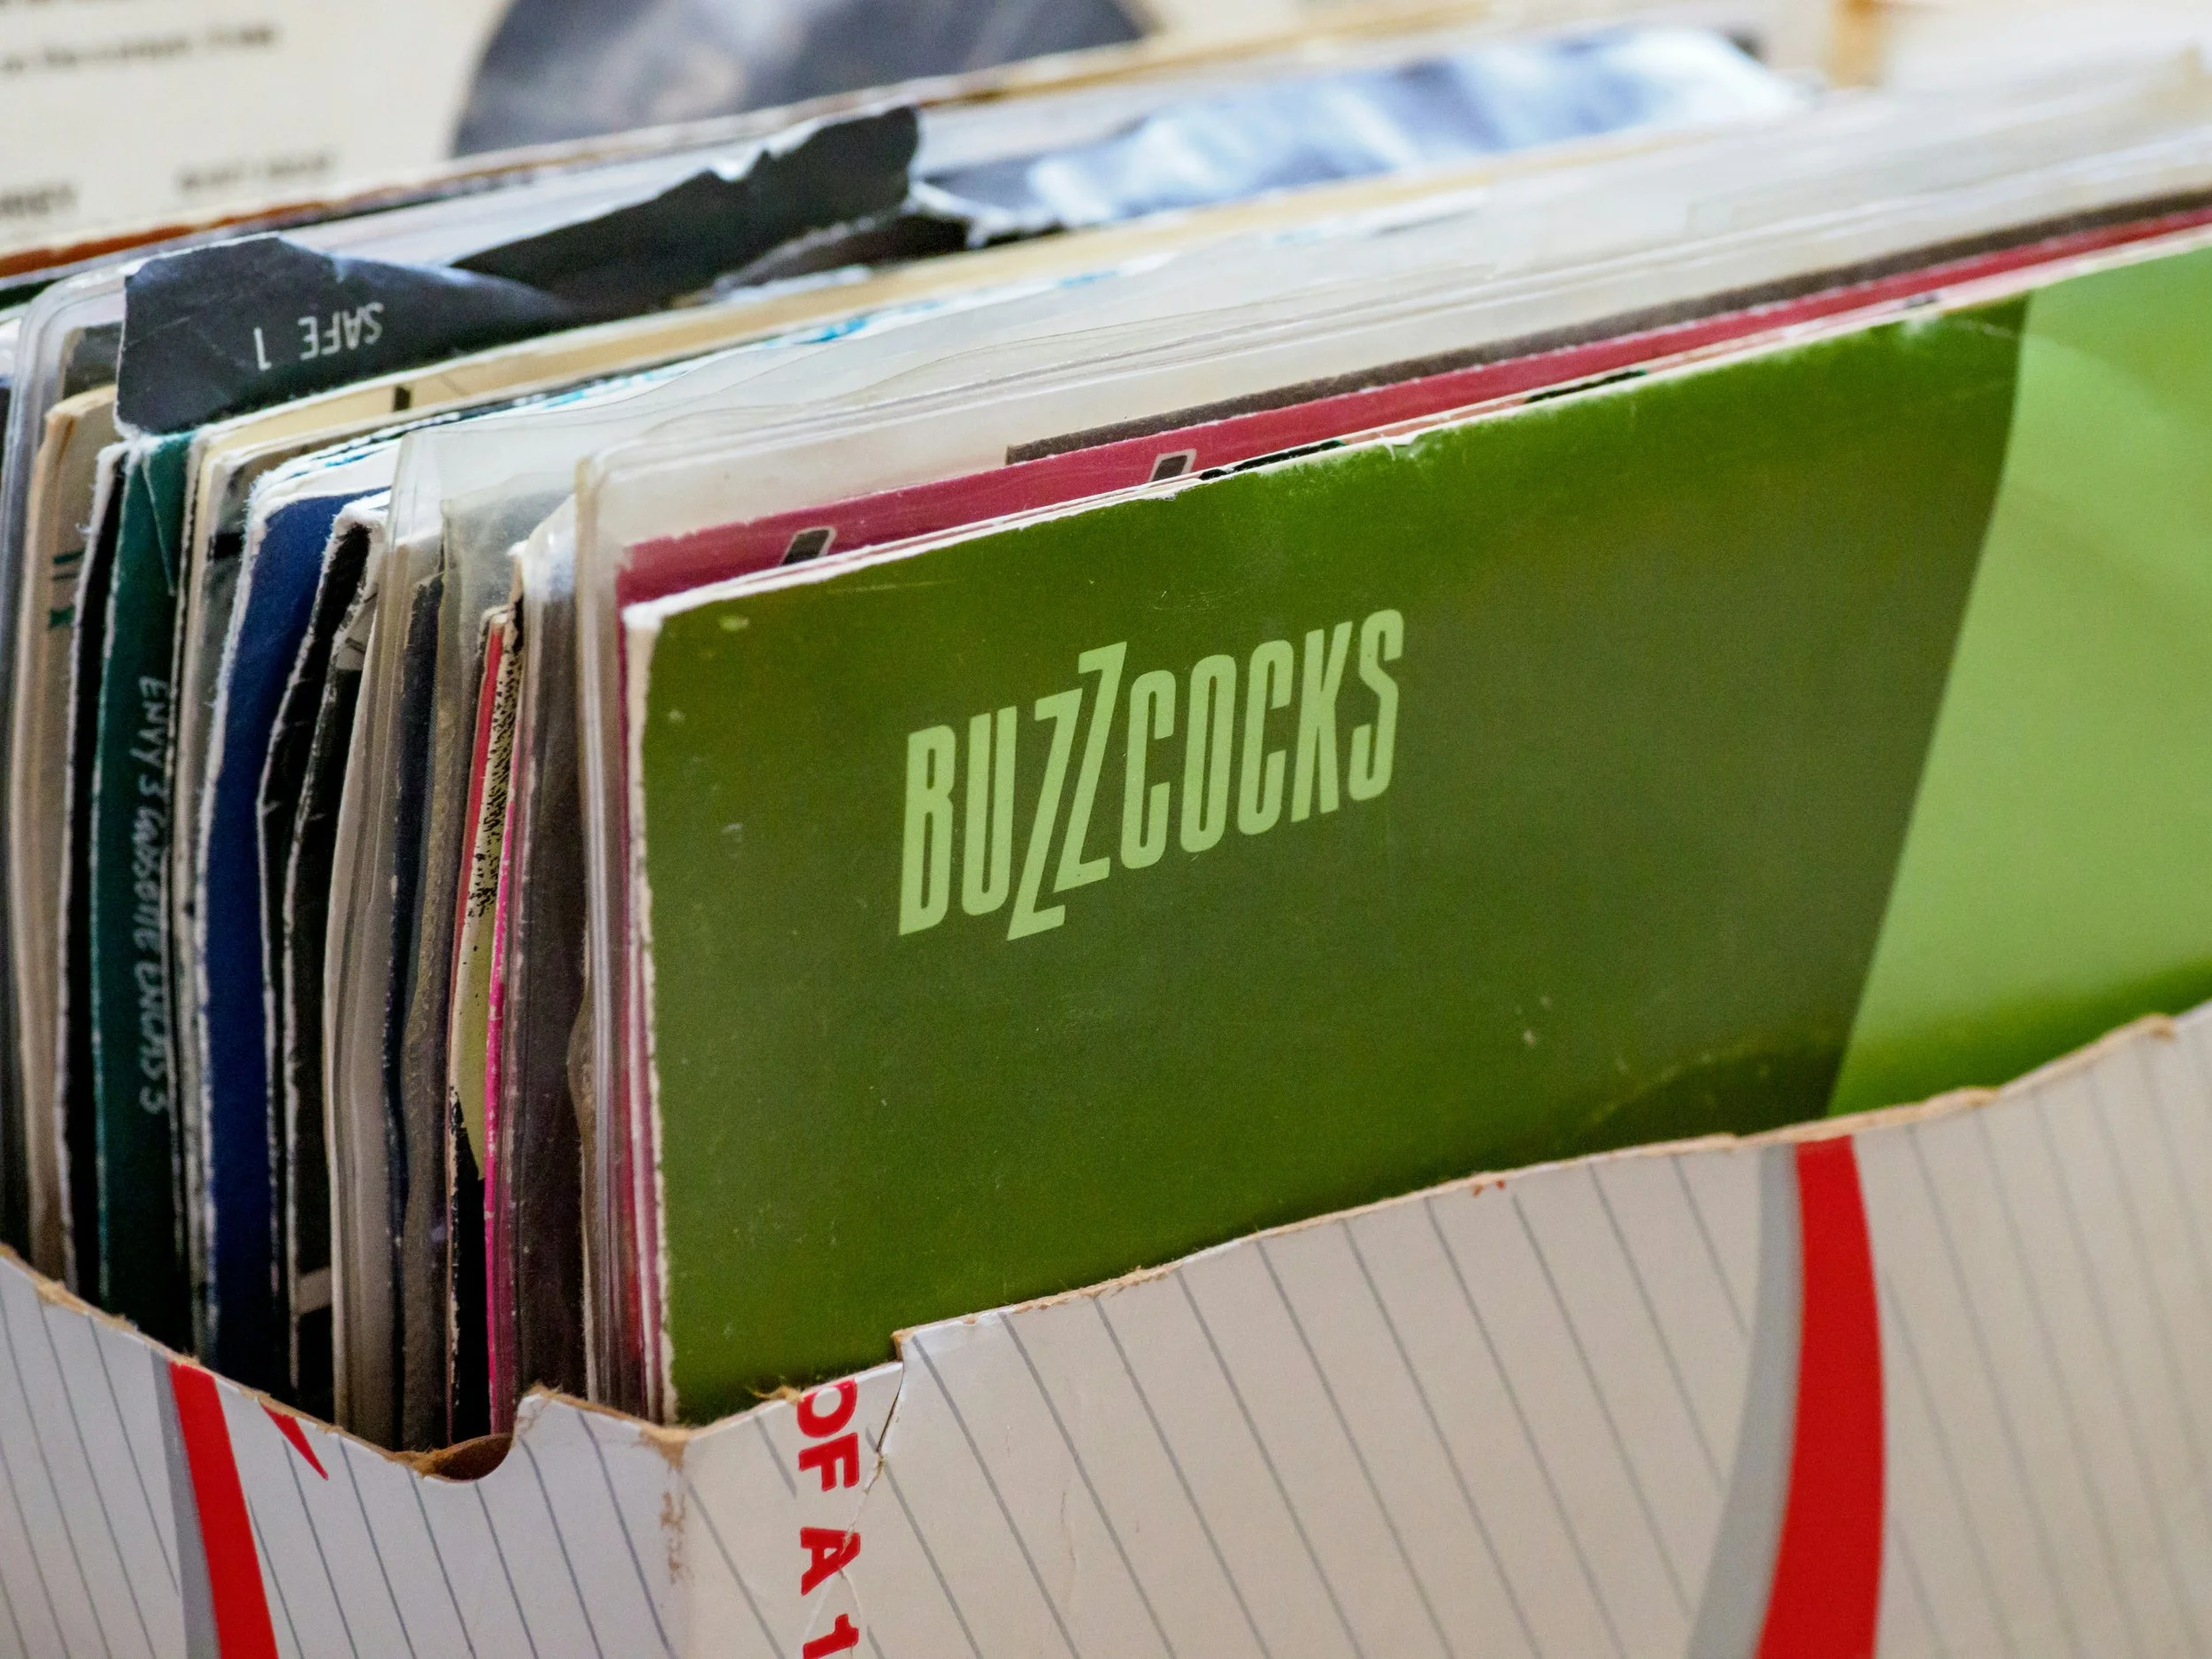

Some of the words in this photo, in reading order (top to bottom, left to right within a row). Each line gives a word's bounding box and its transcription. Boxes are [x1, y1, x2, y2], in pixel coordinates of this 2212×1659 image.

[298, 302, 385, 360] SAFE
[899, 609, 1404, 941] BUZZCOCKS
[797, 1379, 860, 1493] OF
[800, 1526, 861, 1597] A
